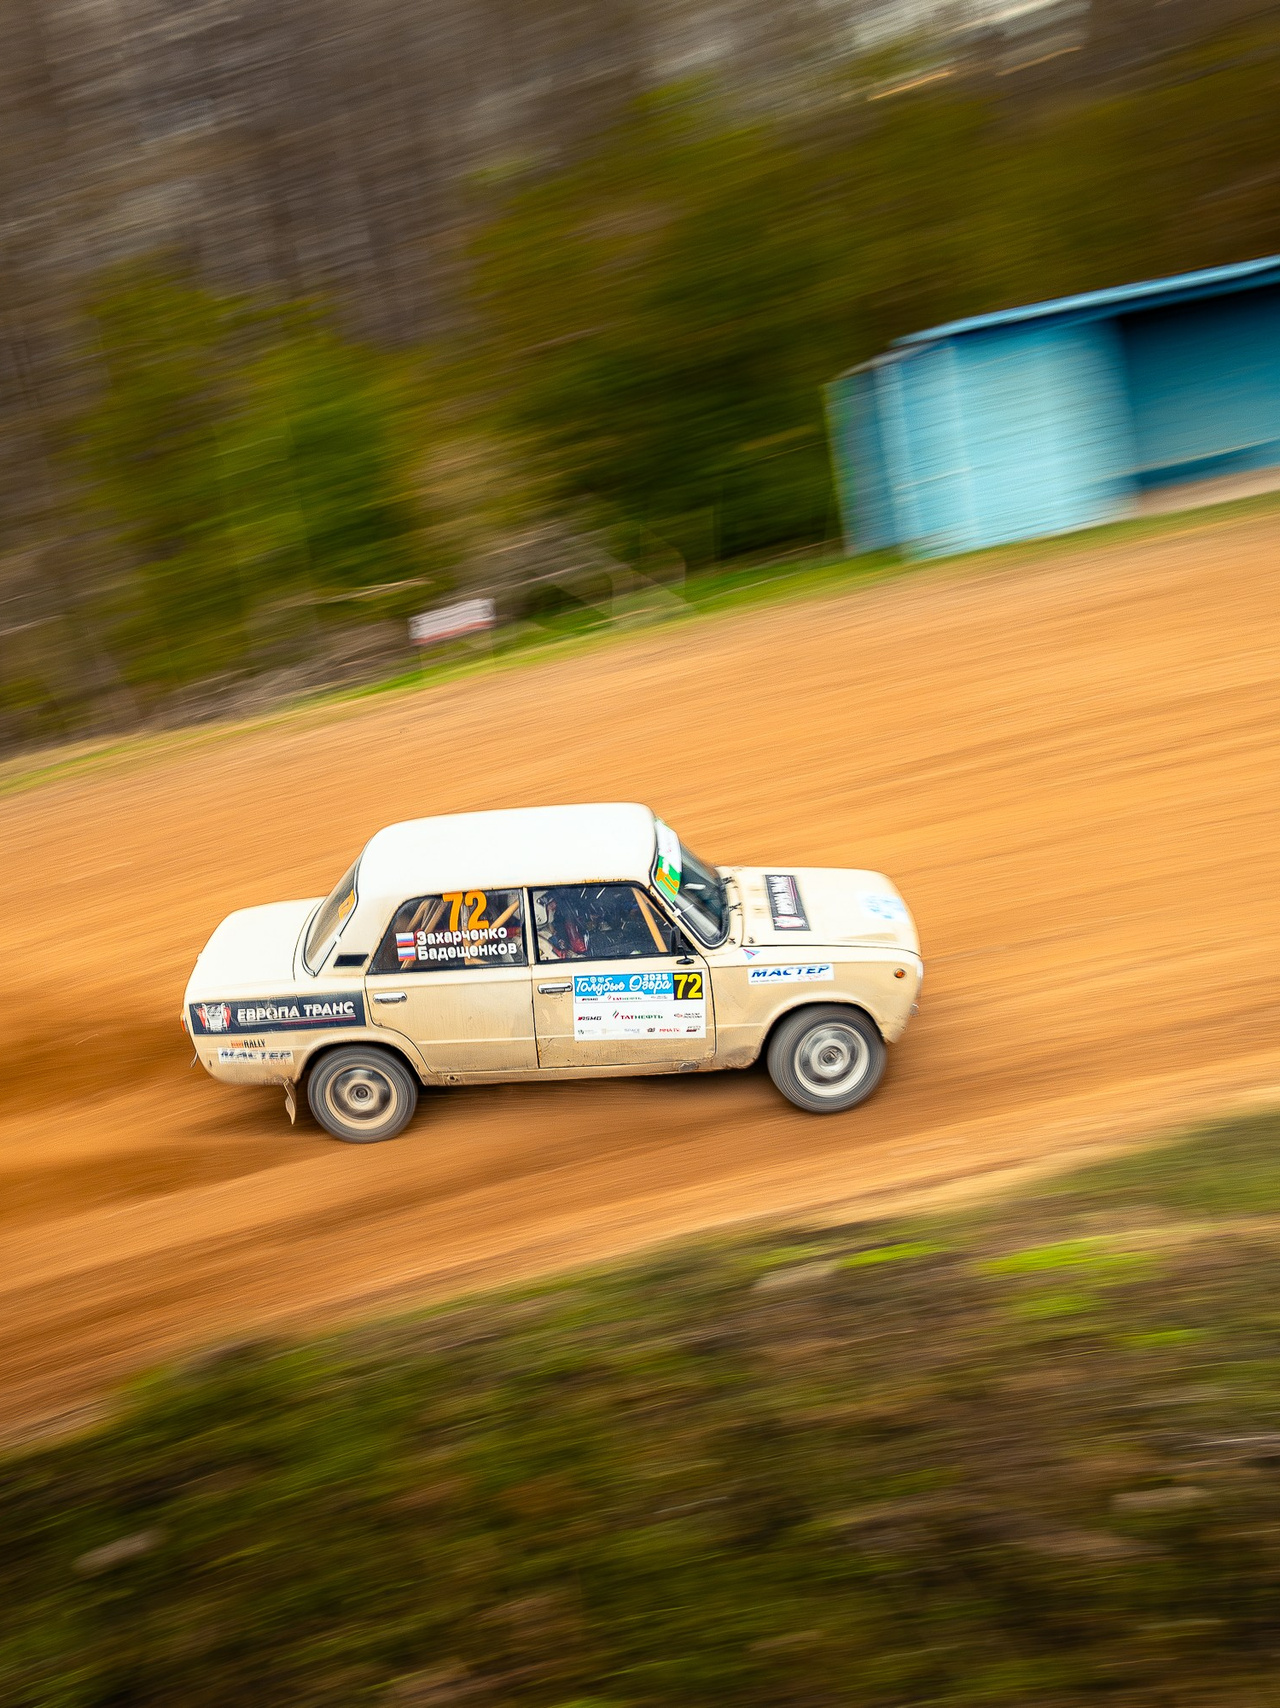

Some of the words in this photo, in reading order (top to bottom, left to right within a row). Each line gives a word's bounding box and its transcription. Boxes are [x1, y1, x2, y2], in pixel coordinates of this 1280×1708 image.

[442, 889, 489, 932] 72
[416, 927, 508, 946] Захарченко
[417, 942, 517, 961] Бадещенков
[751, 965, 830, 978] МАСТЕР
[673, 974, 703, 999] 72
[237, 1005, 300, 1021] ЕВРОПА
[303, 1001, 355, 1017] ТРАНС
